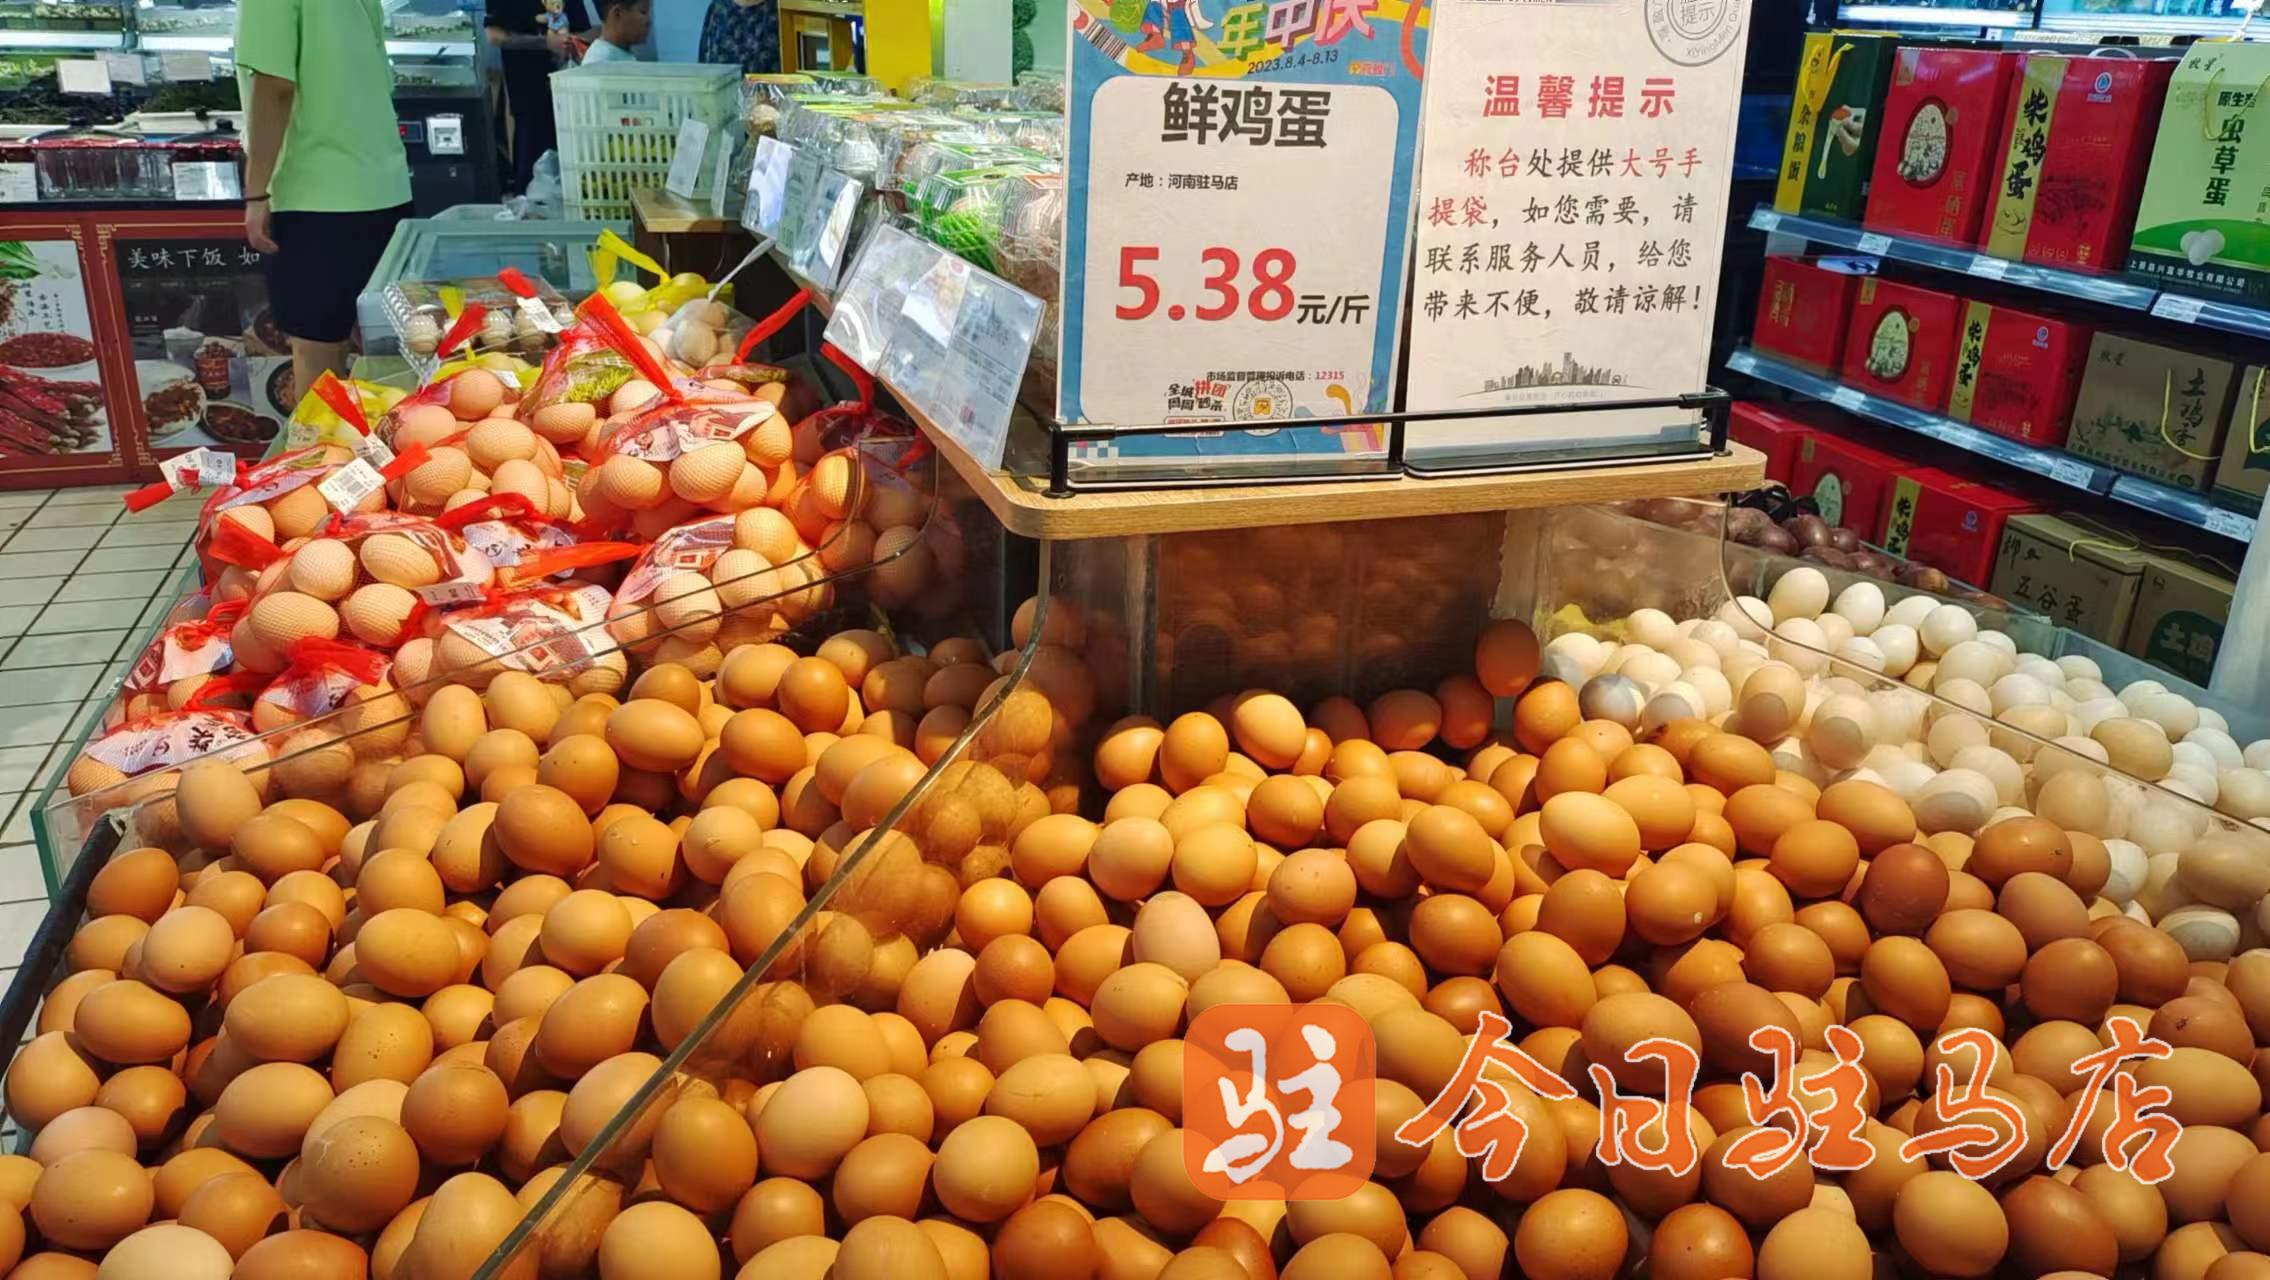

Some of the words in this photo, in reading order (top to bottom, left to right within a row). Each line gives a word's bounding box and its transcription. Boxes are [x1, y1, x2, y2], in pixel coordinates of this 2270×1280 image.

[1247, 49, 1339, 75] 2023.8.4-8.13
[1482, 74, 1677, 119] 温馨提示
[1160, 81, 1332, 149] 鲜鸡蛋
[1464, 147, 1703, 179] 称台处提供大号手
[128, 247, 228, 269] 美味下饭
